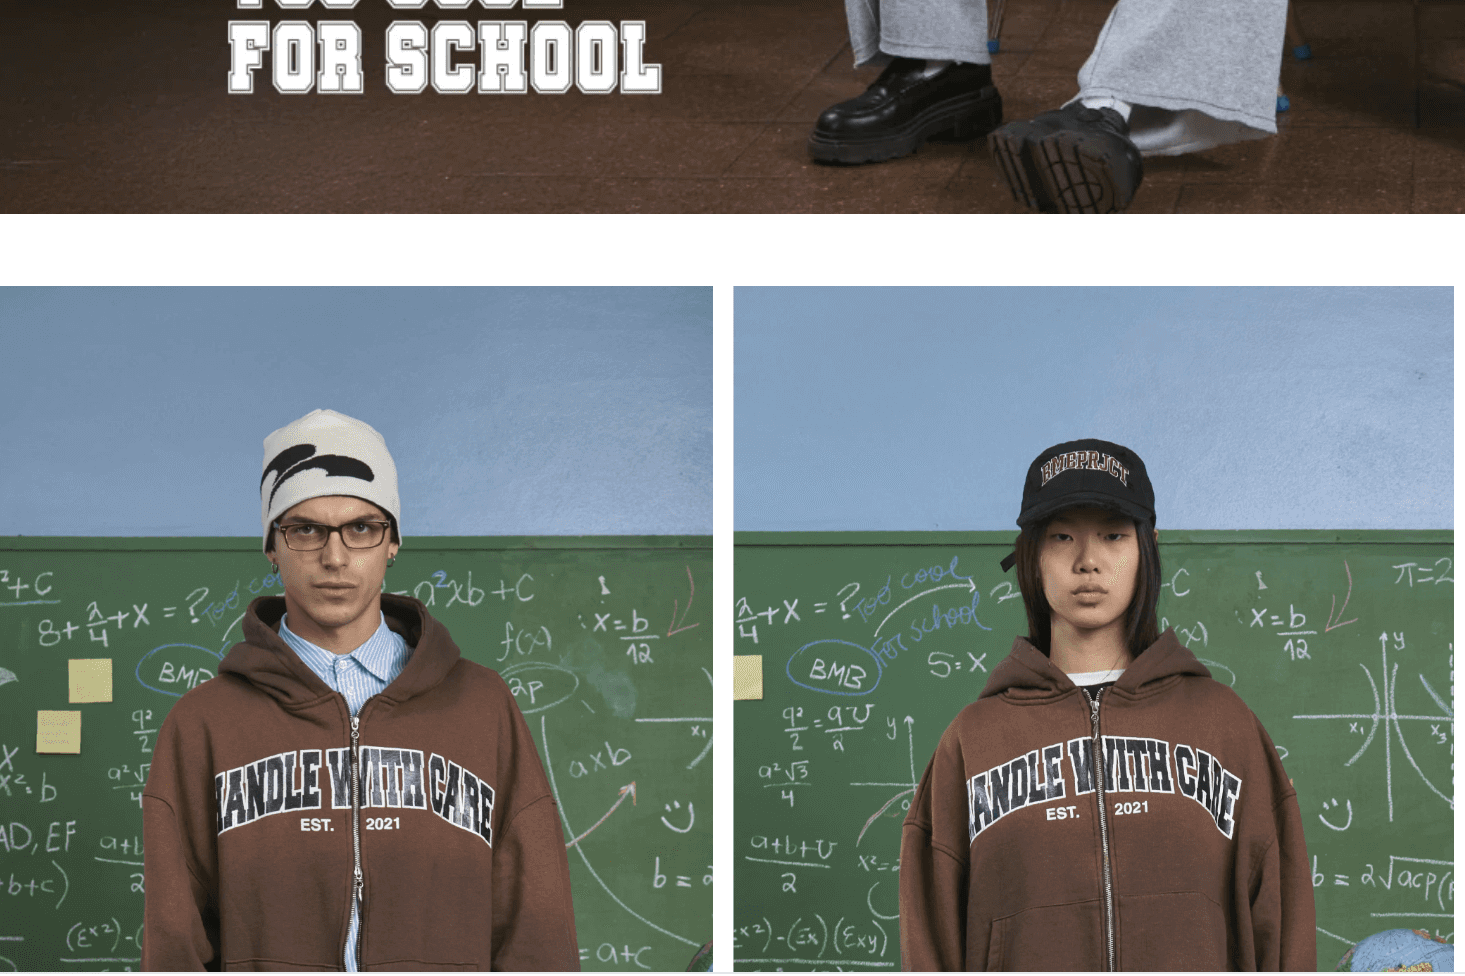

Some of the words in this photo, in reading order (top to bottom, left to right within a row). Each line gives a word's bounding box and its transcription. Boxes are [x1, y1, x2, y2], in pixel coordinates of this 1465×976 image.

[810, 658, 867, 689] BMB
[325, 745, 427, 810] WITH
[428, 752, 495, 848] CARE
[966, 742, 1066, 846] ANDLE
[1067, 735, 1175, 796] WITH
[1173, 743, 1242, 840] CARE
[300, 817, 335, 832] EST.
[366, 817, 401, 830] 2021
[1046, 806, 1080, 821] EST.
[1114, 801, 1149, 816] 2021
